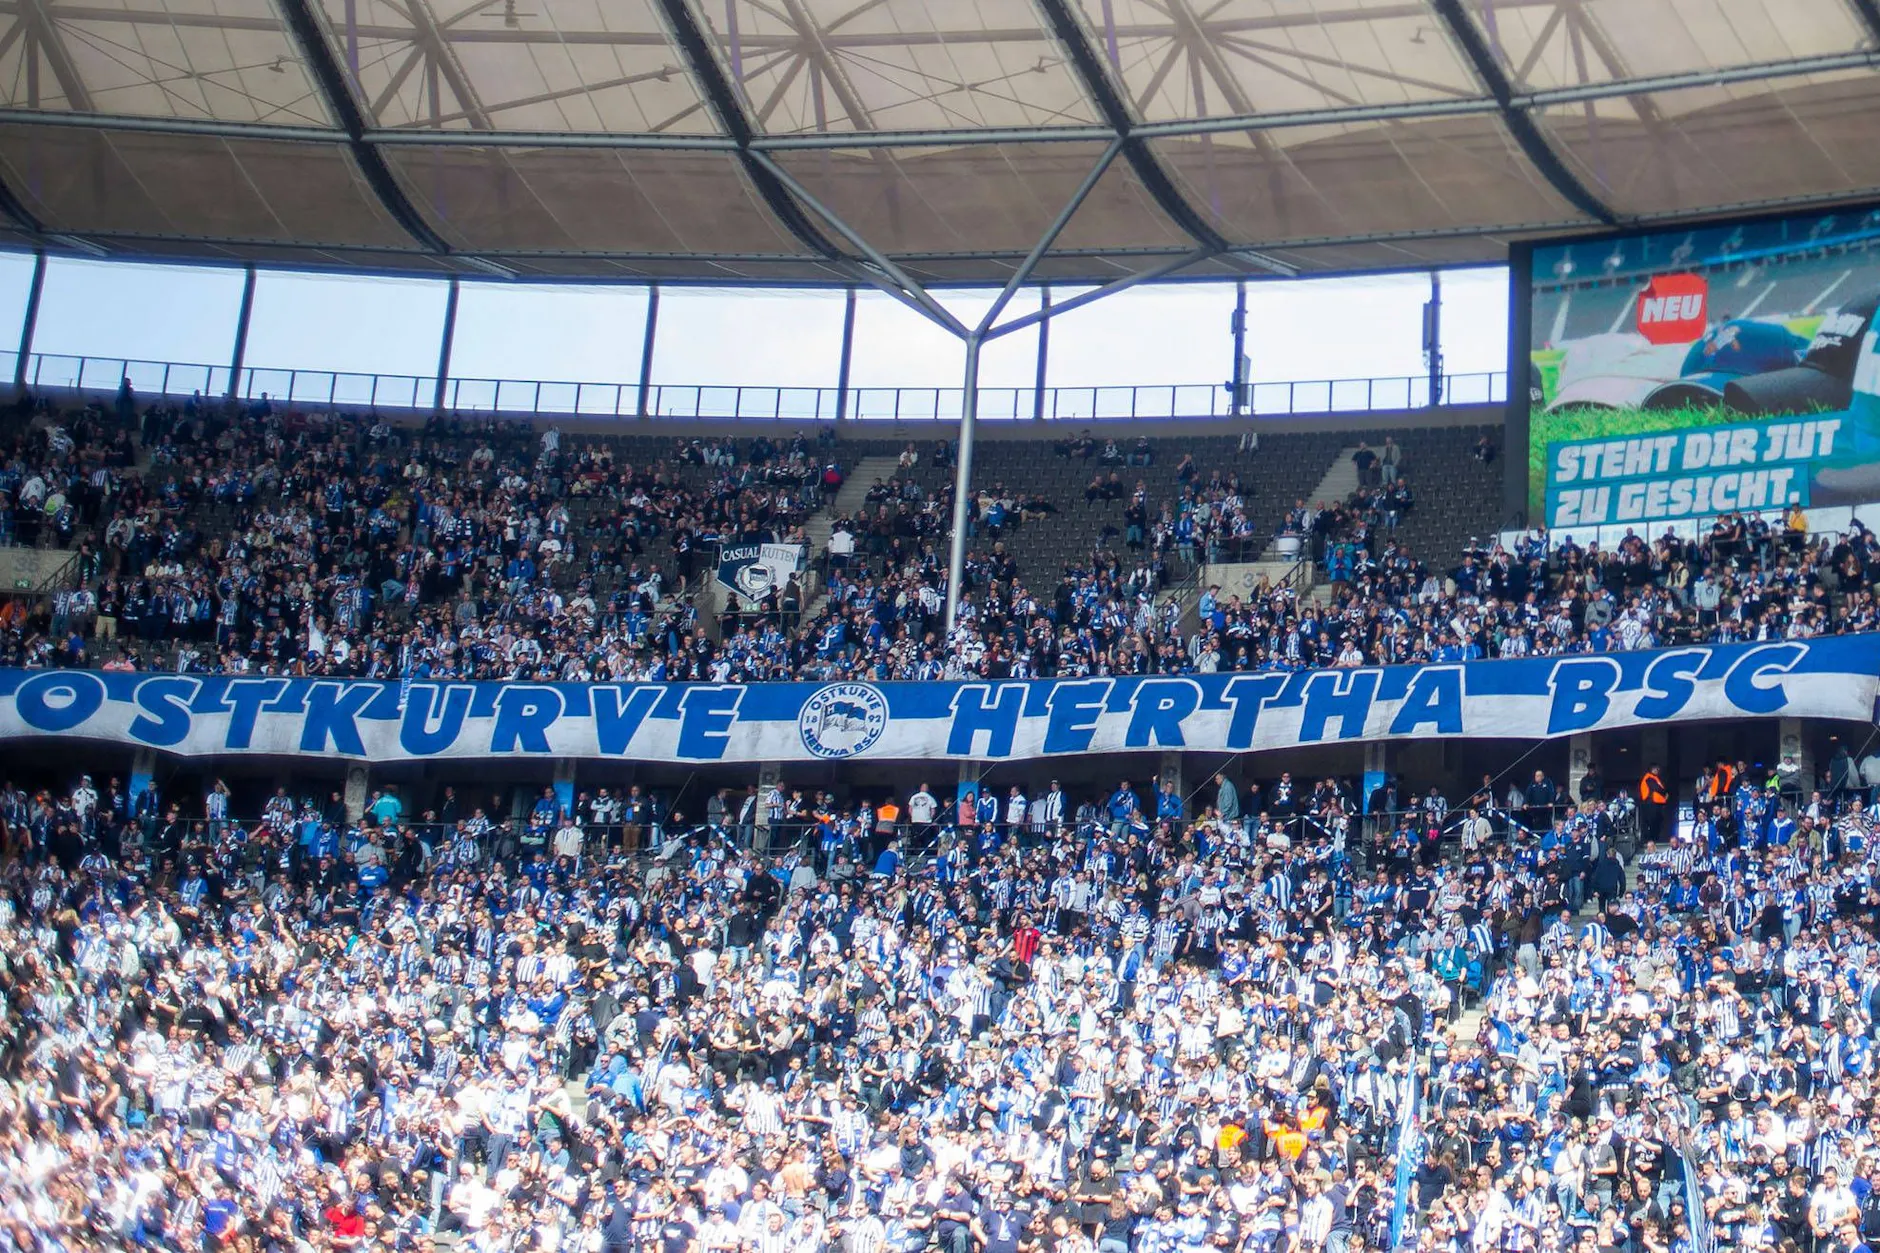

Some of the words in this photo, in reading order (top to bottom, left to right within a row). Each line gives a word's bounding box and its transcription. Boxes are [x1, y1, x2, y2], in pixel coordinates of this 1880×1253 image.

[1641, 294, 1703, 324] NEU
[1555, 436, 1679, 483] STEHT
[1682, 428, 1759, 470] DIR
[1763, 419, 1842, 463] JUT
[1555, 486, 1610, 528] ZU
[1616, 468, 1800, 518] GESICHT.
[722, 547, 760, 562] CASUAL
[761, 546, 797, 562] KUTTEN
[811, 686, 882, 711] OSTKURVE
[946, 665, 1467, 758] HERTHA
[1546, 641, 1810, 736] BSC
[13, 670, 748, 760] OSTKURVE
[805, 715, 818, 724] 18
[868, 714, 882, 723] 92
[804, 727, 850, 756] HERTHA
[853, 727, 880, 753] BSC
